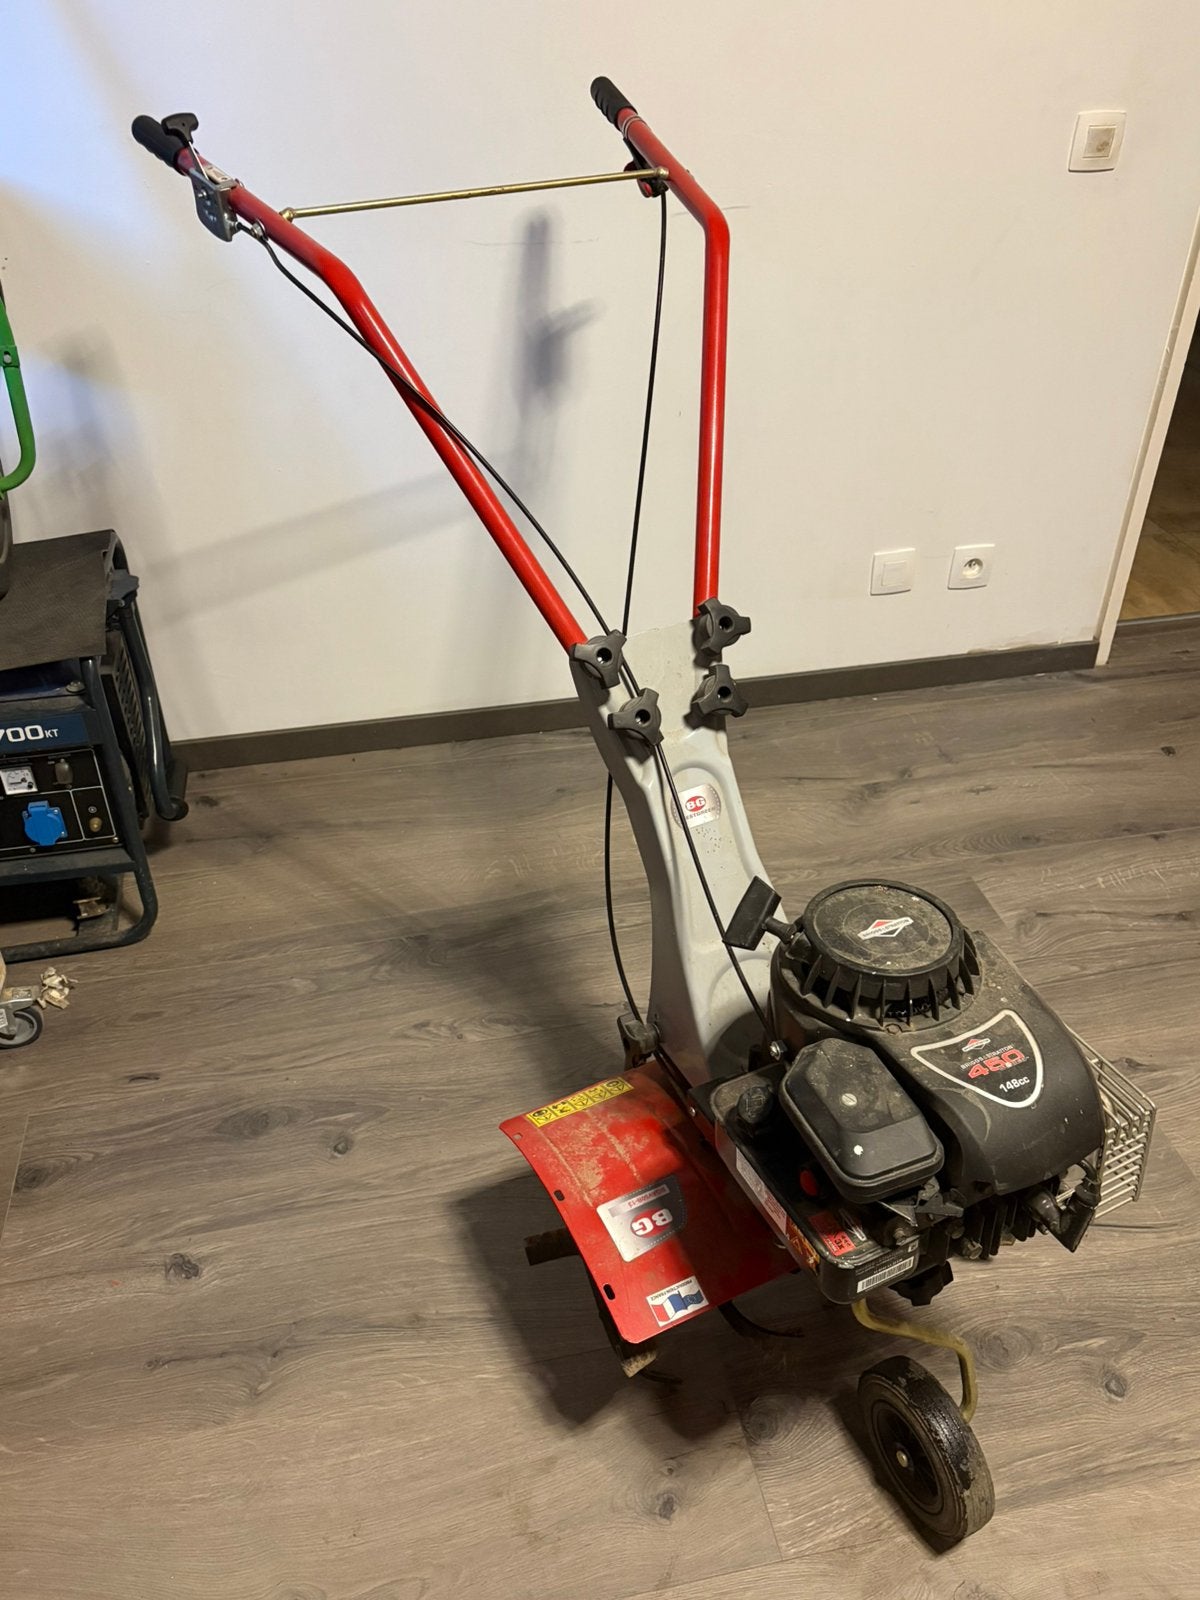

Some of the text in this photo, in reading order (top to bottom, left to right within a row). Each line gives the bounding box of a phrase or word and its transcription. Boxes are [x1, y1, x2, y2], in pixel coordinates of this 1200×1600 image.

[968, 1048, 1025, 1079] 450
[999, 1076, 1030, 1093] 148cc
[631, 1208, 673, 1236] BG
